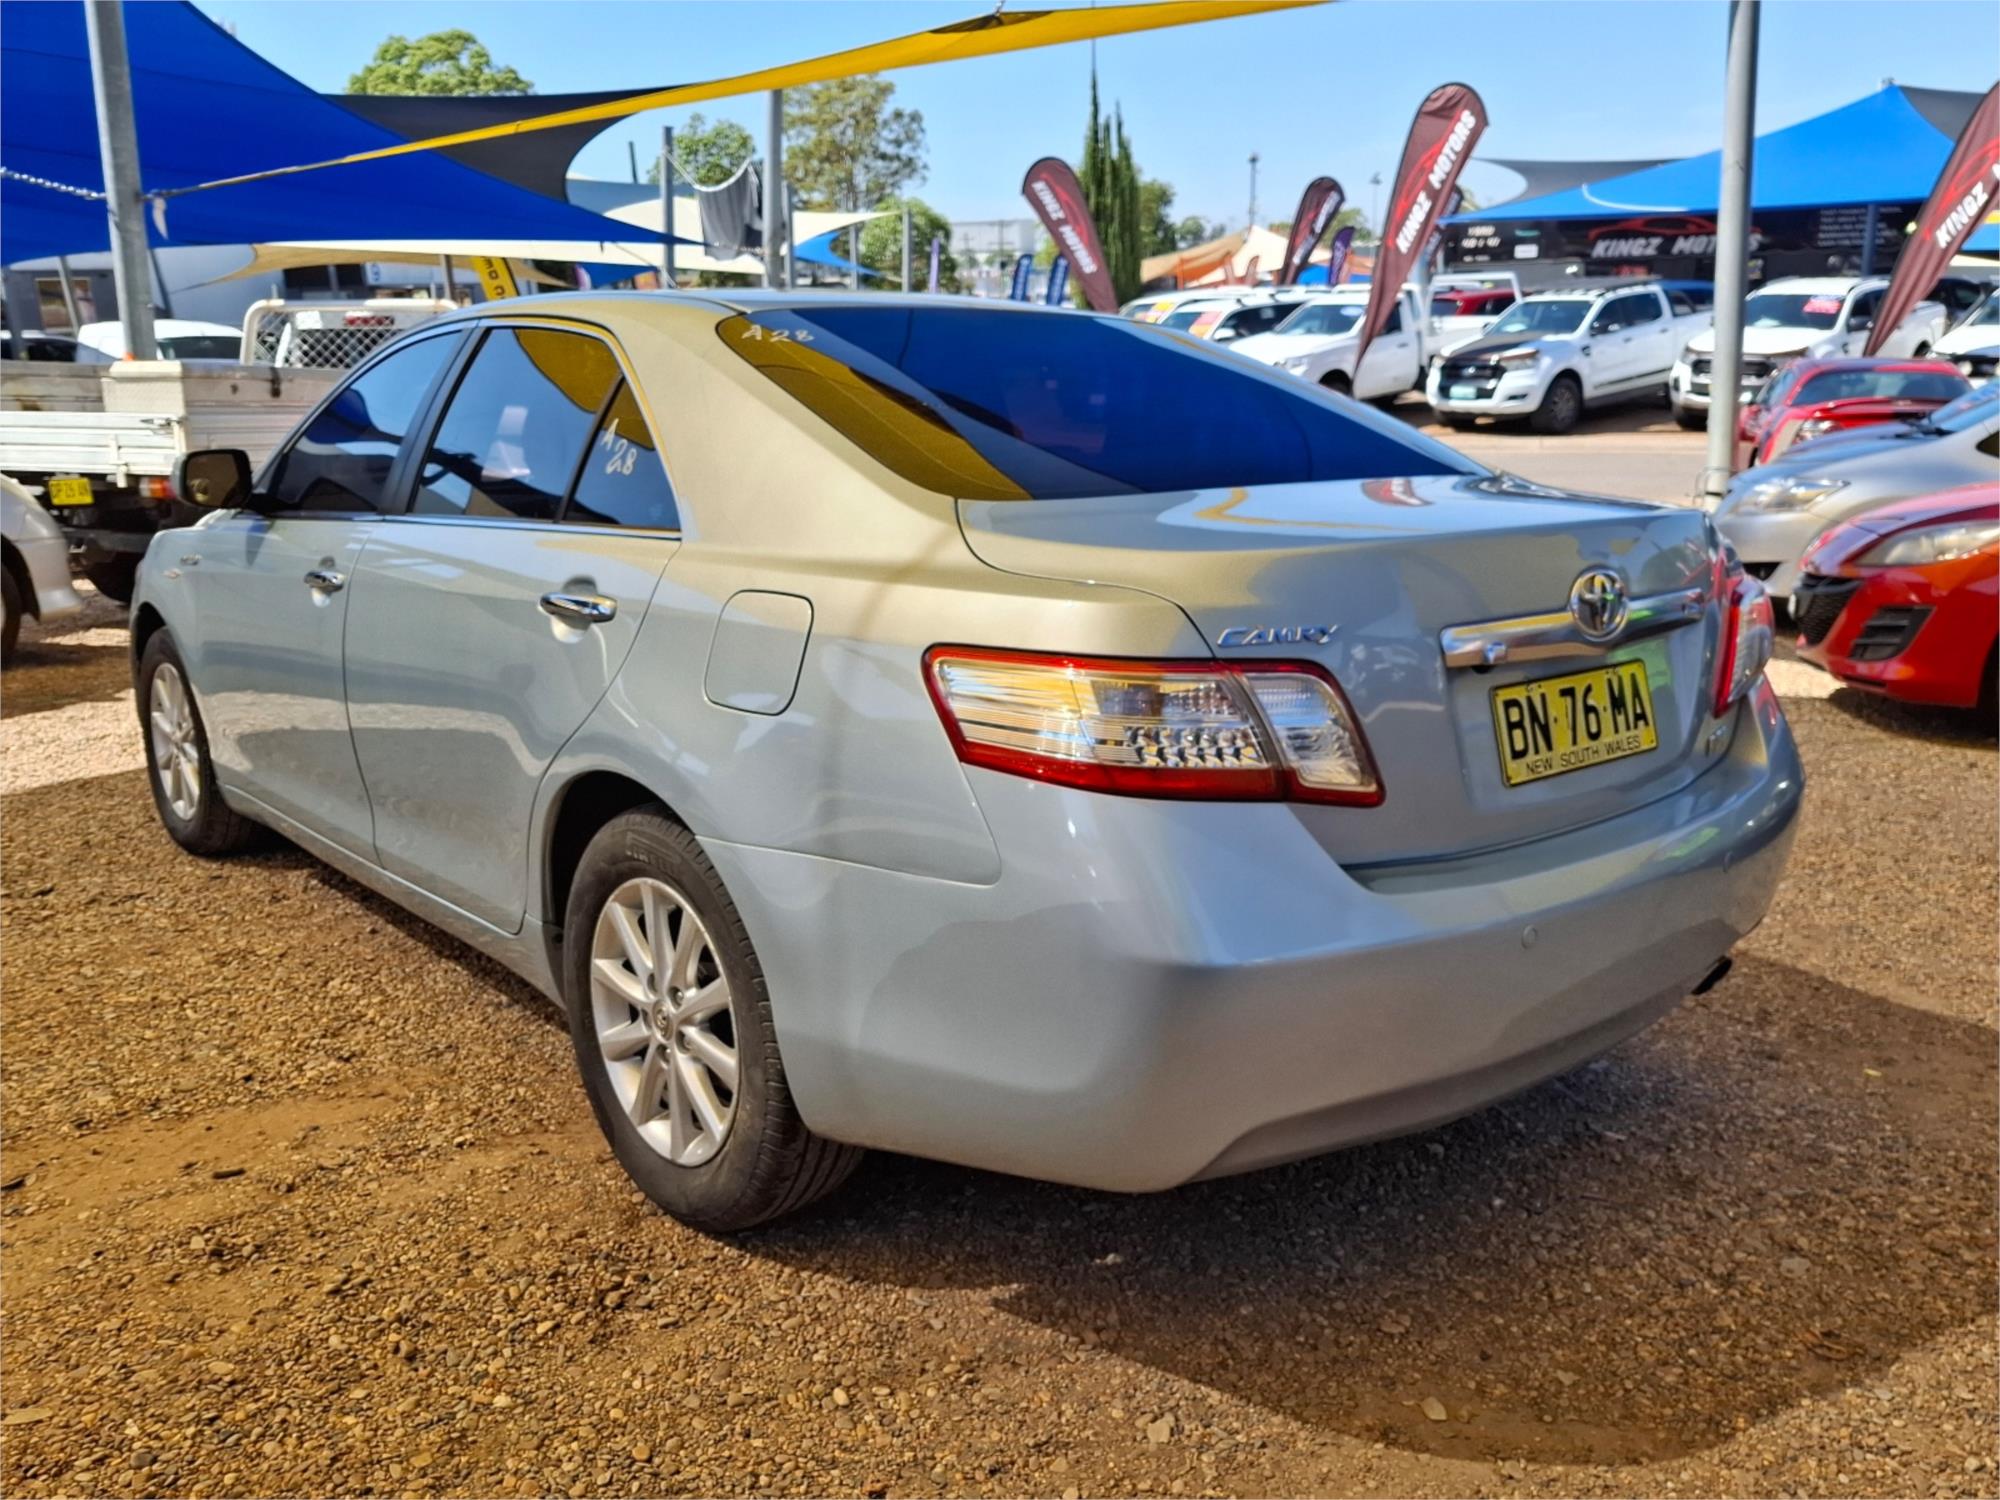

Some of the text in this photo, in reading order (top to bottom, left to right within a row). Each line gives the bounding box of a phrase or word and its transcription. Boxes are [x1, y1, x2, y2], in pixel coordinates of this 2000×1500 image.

[1396, 190, 1432, 254] KINGZ
[1428, 109, 1476, 190] MOTORS
[1031, 180, 1066, 221] KINGZ
[1058, 224, 1098, 274] MOTORS
[1936, 181, 1988, 249] KINGZ
[1591, 233, 1764, 258] KINGZ MOTS
[1217, 624, 1338, 647] CAMRY
[1526, 735, 1641, 775] NEW SOUTH WALES
